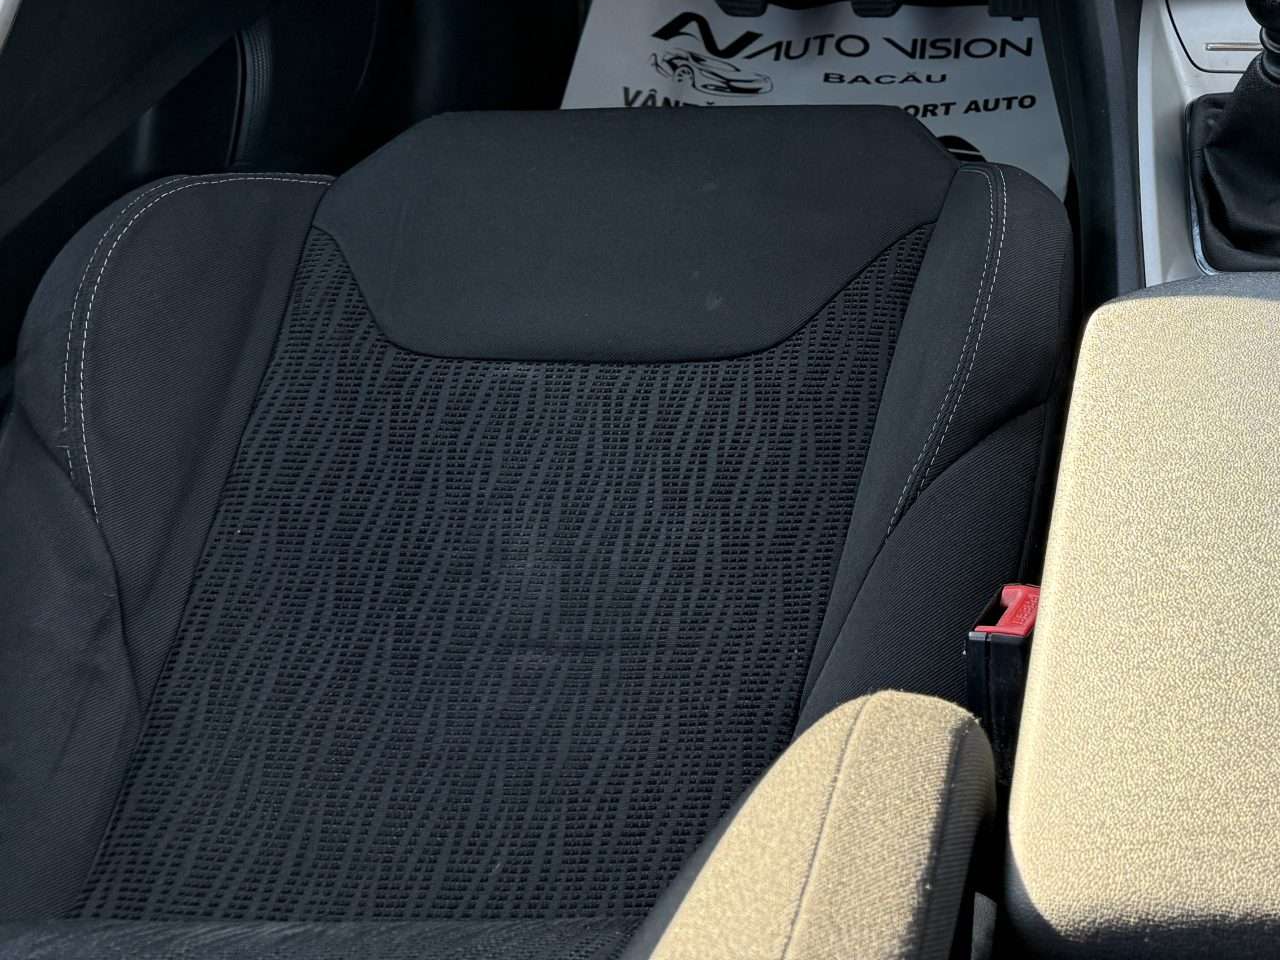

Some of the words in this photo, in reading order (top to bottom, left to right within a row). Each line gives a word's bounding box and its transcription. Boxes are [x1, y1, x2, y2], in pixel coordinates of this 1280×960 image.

[745, 34, 870, 62] AUTO
[882, 36, 1034, 61] VISION
[823, 71, 948, 86] BACĂU
[963, 95, 1037, 114] AUTO
